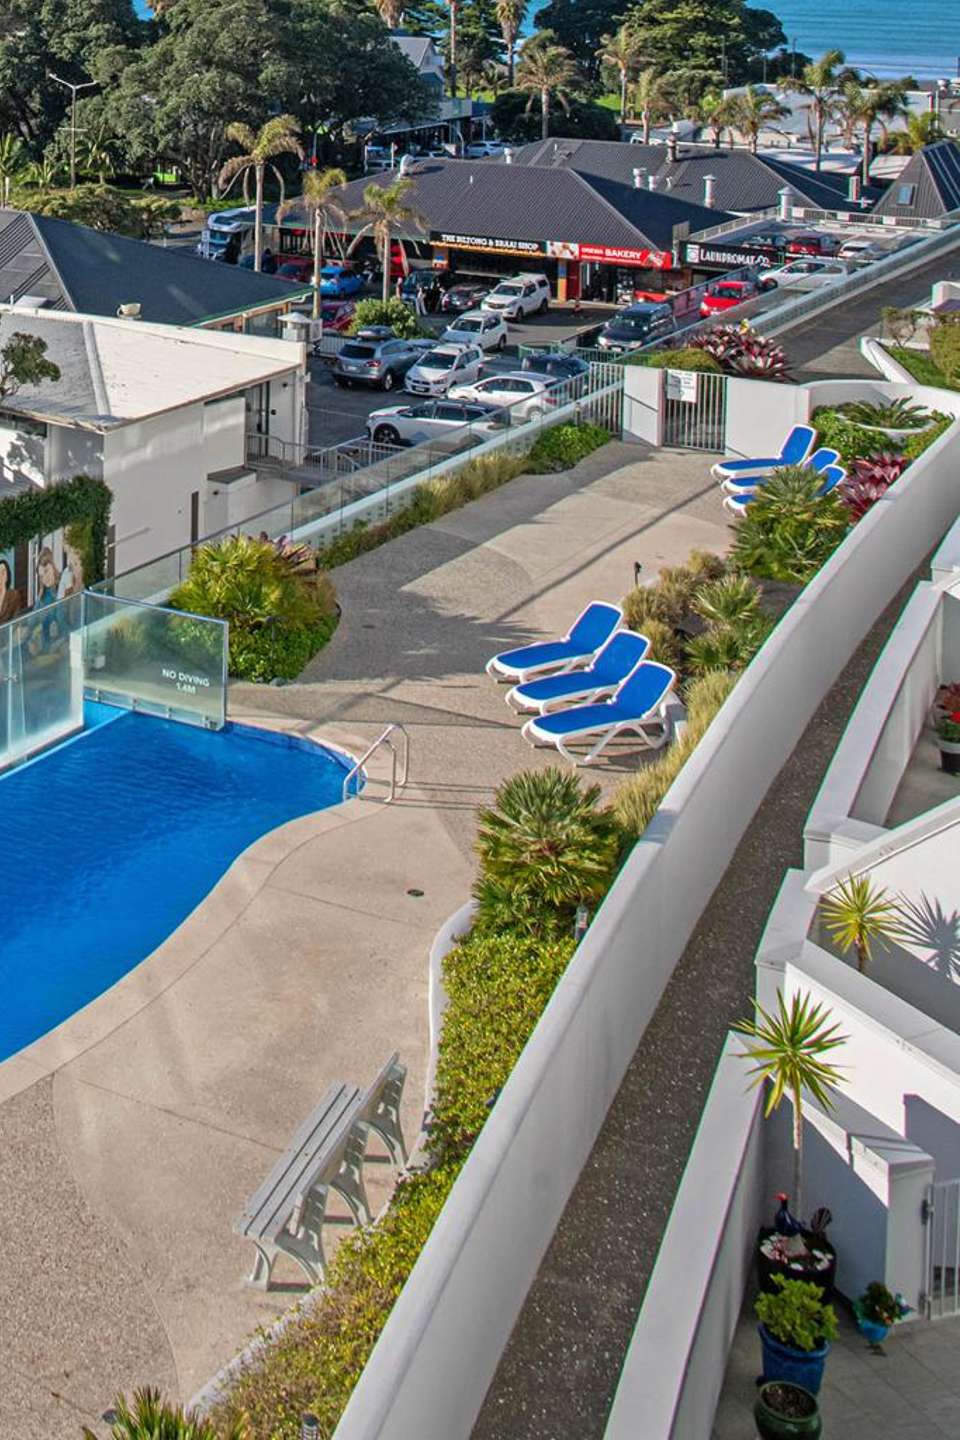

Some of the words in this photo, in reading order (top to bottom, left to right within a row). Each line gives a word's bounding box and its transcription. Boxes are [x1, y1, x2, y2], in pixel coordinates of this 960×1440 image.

[518, 241, 539, 250] SHOP
[605, 248, 641, 259] BAKERY
[700, 248, 755, 265] LAUNDROMAT
[162, 669, 177, 679] NO
[178, 671, 210, 687] DIVING
